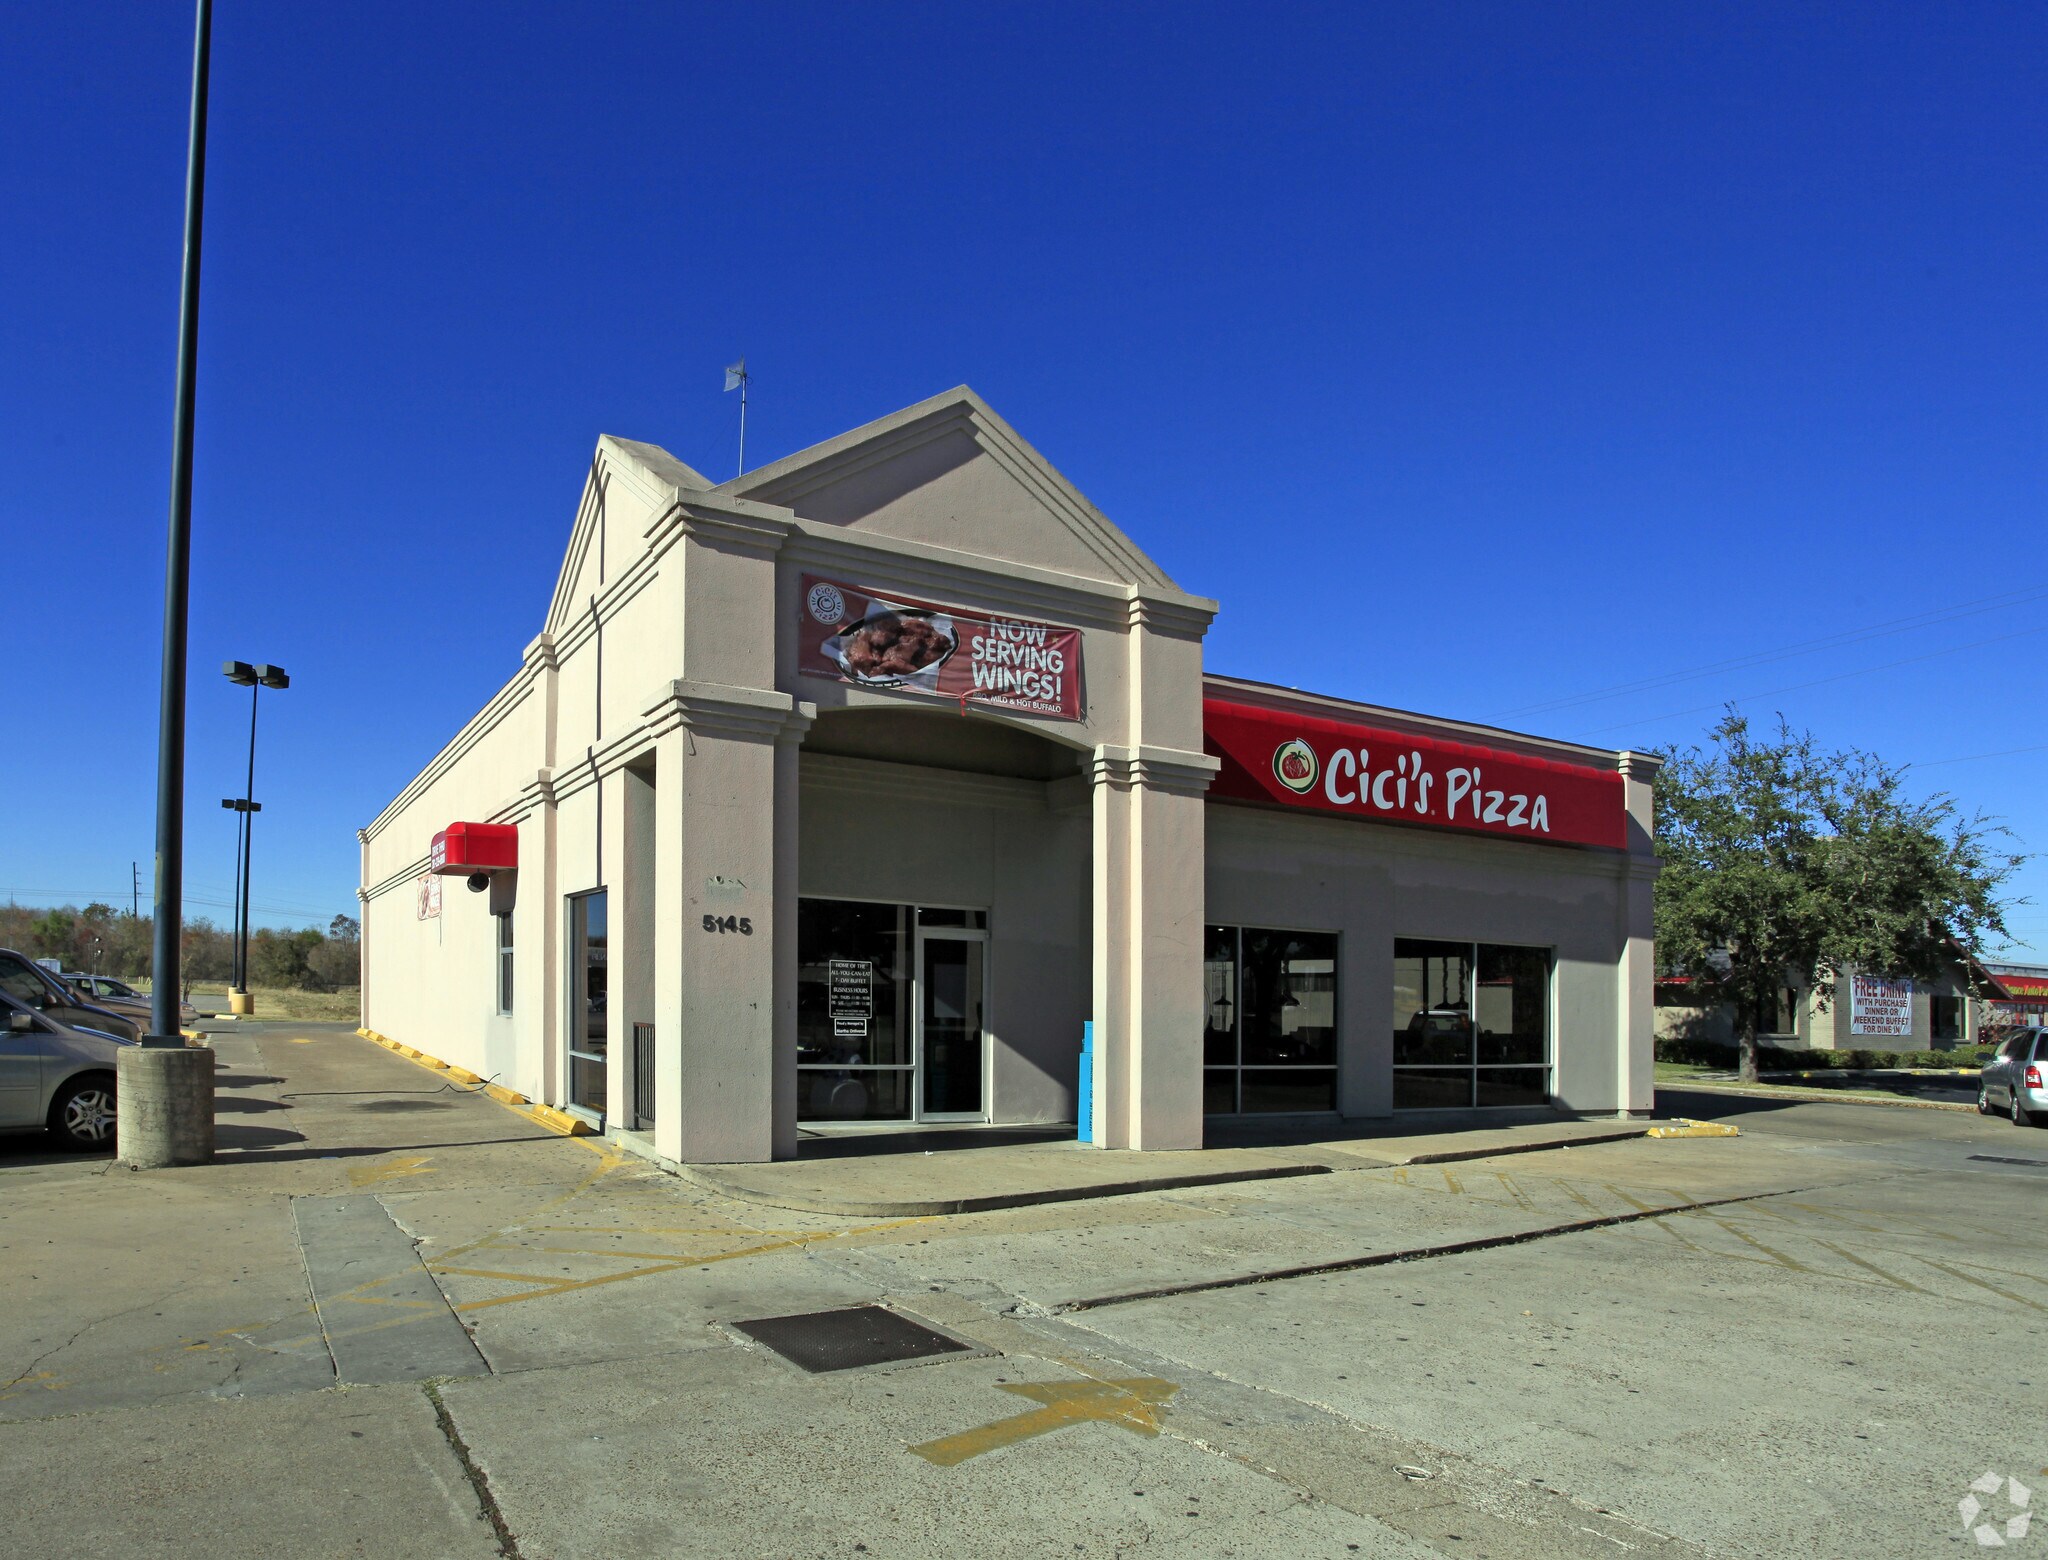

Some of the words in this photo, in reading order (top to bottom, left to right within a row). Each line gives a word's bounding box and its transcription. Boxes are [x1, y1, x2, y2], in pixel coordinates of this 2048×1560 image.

[990, 616, 1047, 647] NOW
[971, 635, 1064, 673] SERVING
[971, 661, 1062, 702] WINGS!
[990, 695, 1008, 704] MILD
[1009, 698, 1016, 706] &
[1016, 699, 1031, 708] HOT
[1032, 702, 1062, 713] BUFFALO
[702, 914, 753, 936] 5145
[1855, 977, 1878, 997] FREE
[1881, 979, 1907, 999] DRINK
[1857, 998, 1873, 1006] WITH
[1874, 998, 1907, 1008] PURCHASE
[1865, 1007, 1888, 1015] DINNER
[1889, 1008, 1899, 1016] OR
[1854, 1016, 1884, 1025] WEEKEND
[1886, 1017, 1909, 1026] BUFFET
[1863, 1025, 1875, 1033] FOR
[1877, 1026, 1892, 1034] DINE
[1893, 1026, 1901, 1034] IN
